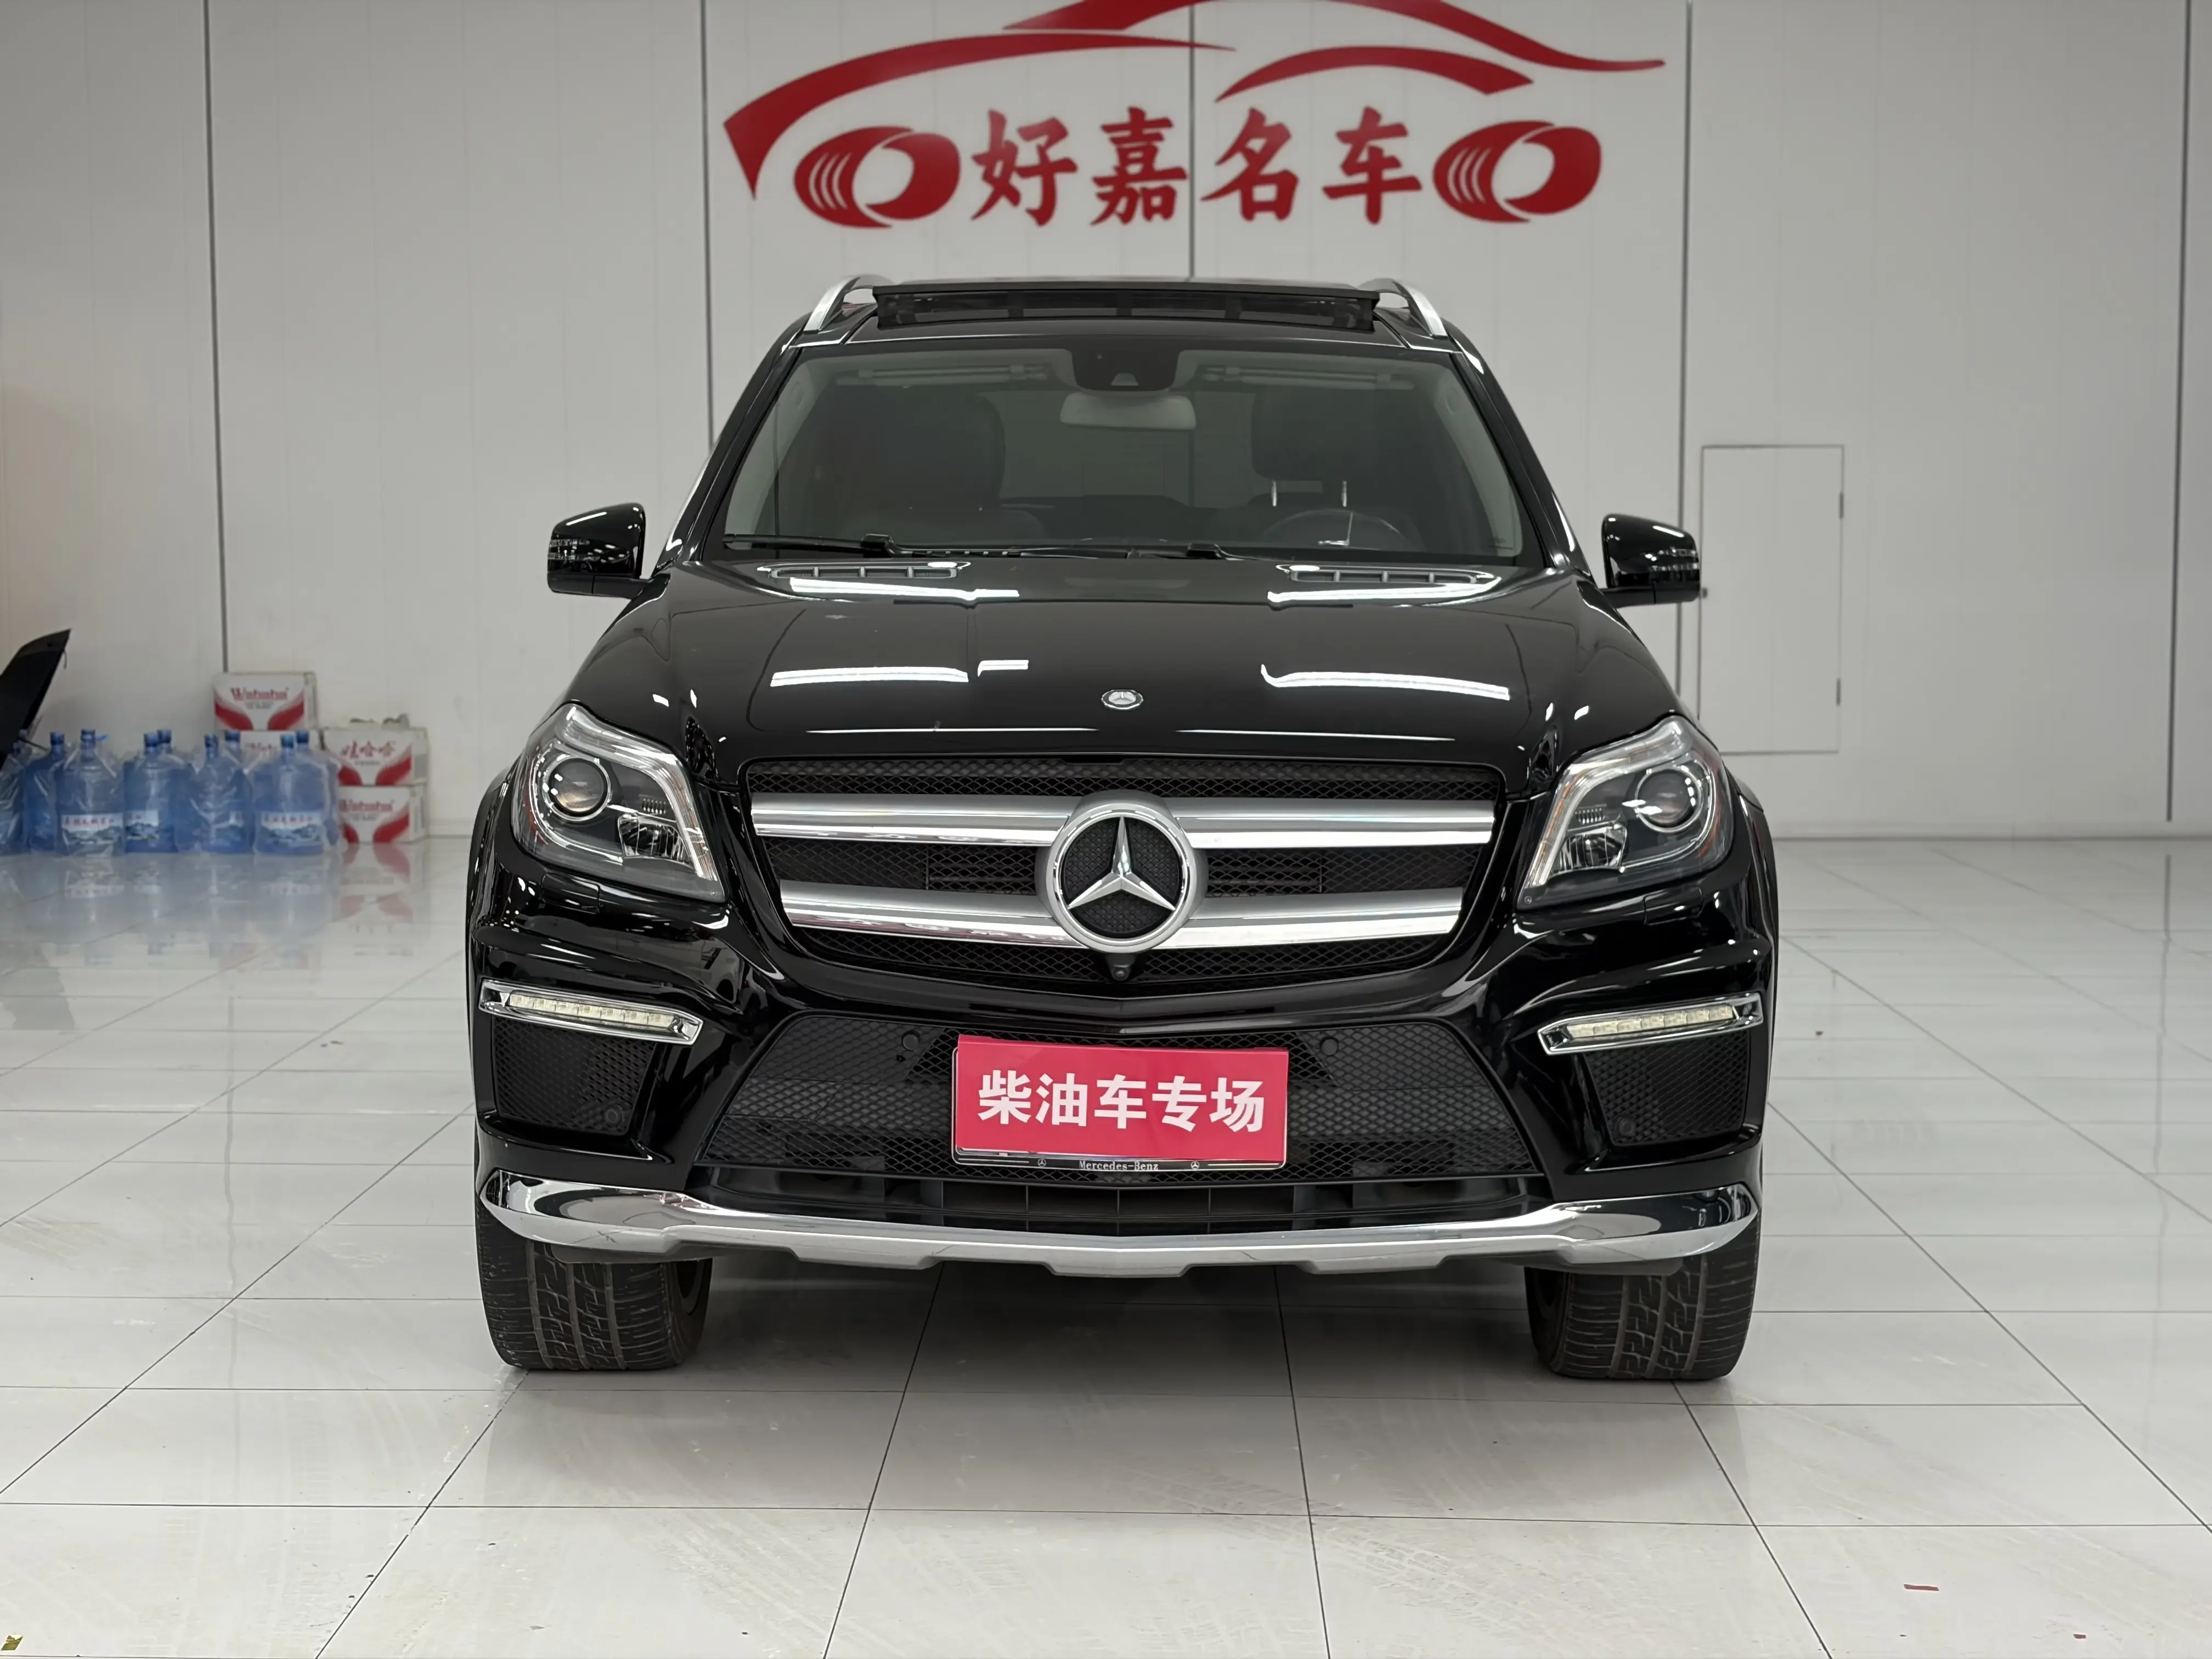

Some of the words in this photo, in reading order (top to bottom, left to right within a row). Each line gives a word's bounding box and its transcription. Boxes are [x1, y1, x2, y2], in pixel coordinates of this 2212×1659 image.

[970, 106, 1422, 226] 好嘉名车
[977, 1069, 1265, 1133] 柴油车专场
[1079, 1160, 1159, 1171] Mercedes-Benz
